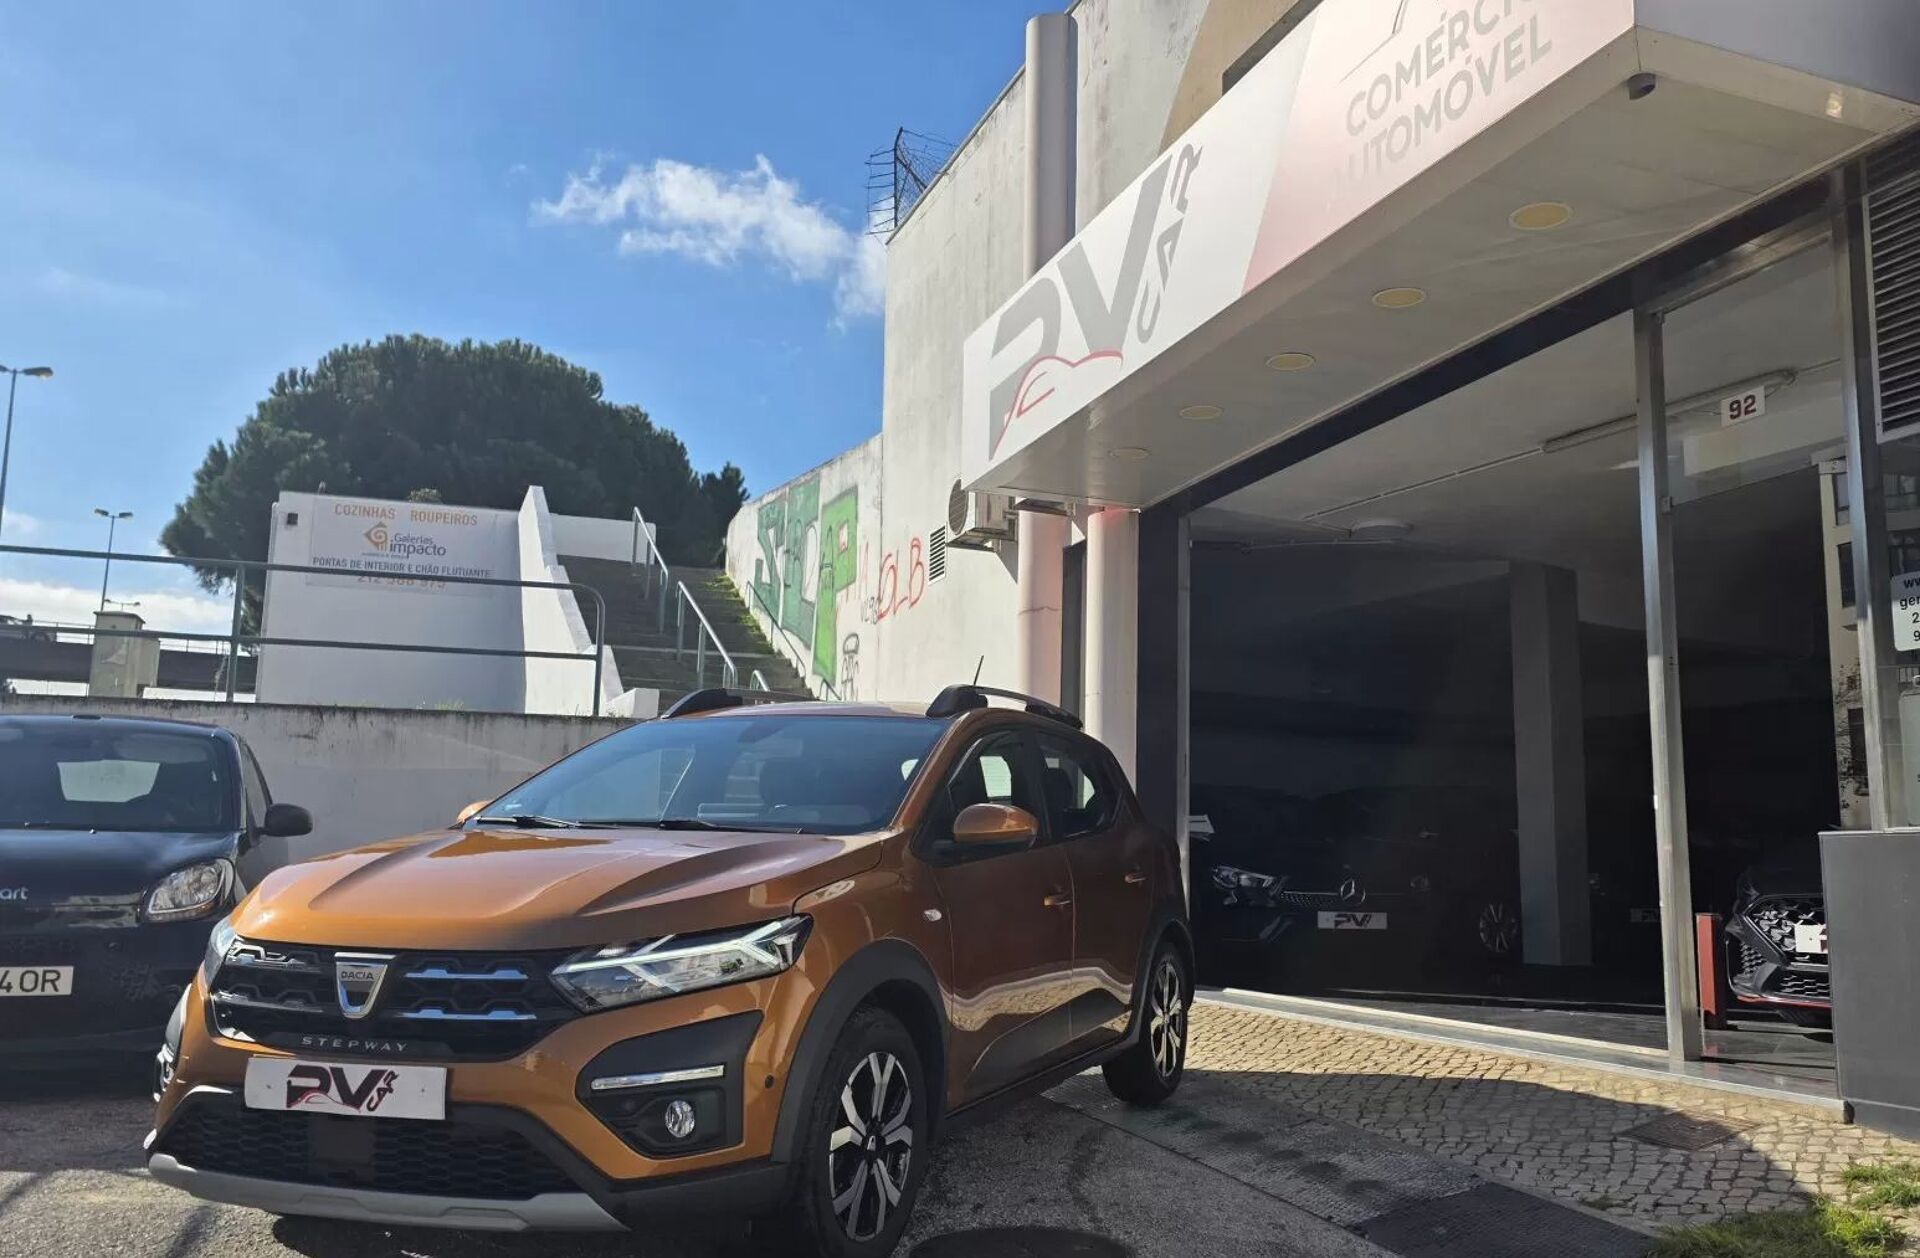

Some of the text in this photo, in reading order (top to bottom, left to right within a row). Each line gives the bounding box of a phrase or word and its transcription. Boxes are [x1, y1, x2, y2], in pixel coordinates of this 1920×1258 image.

[1345, 0, 1533, 137] COMÉRC
[1332, 15, 1552, 195] UTOMÓVEL
[1729, 394, 1757, 420] 92
[334, 503, 479, 526] COZINHAS ROUPEIROS
[389, 539, 447, 559] impacto
[394, 532, 434, 545] Galerias
[312, 556, 348, 569] PORTAS
[350, 559, 363, 570] DE
[364, 560, 405, 573] INTERIOR
[442, 565, 491, 579] FLUTUANTE
[340, 970, 375, 981] DACIA
[301, 1036, 408, 1052] STEPWAY
